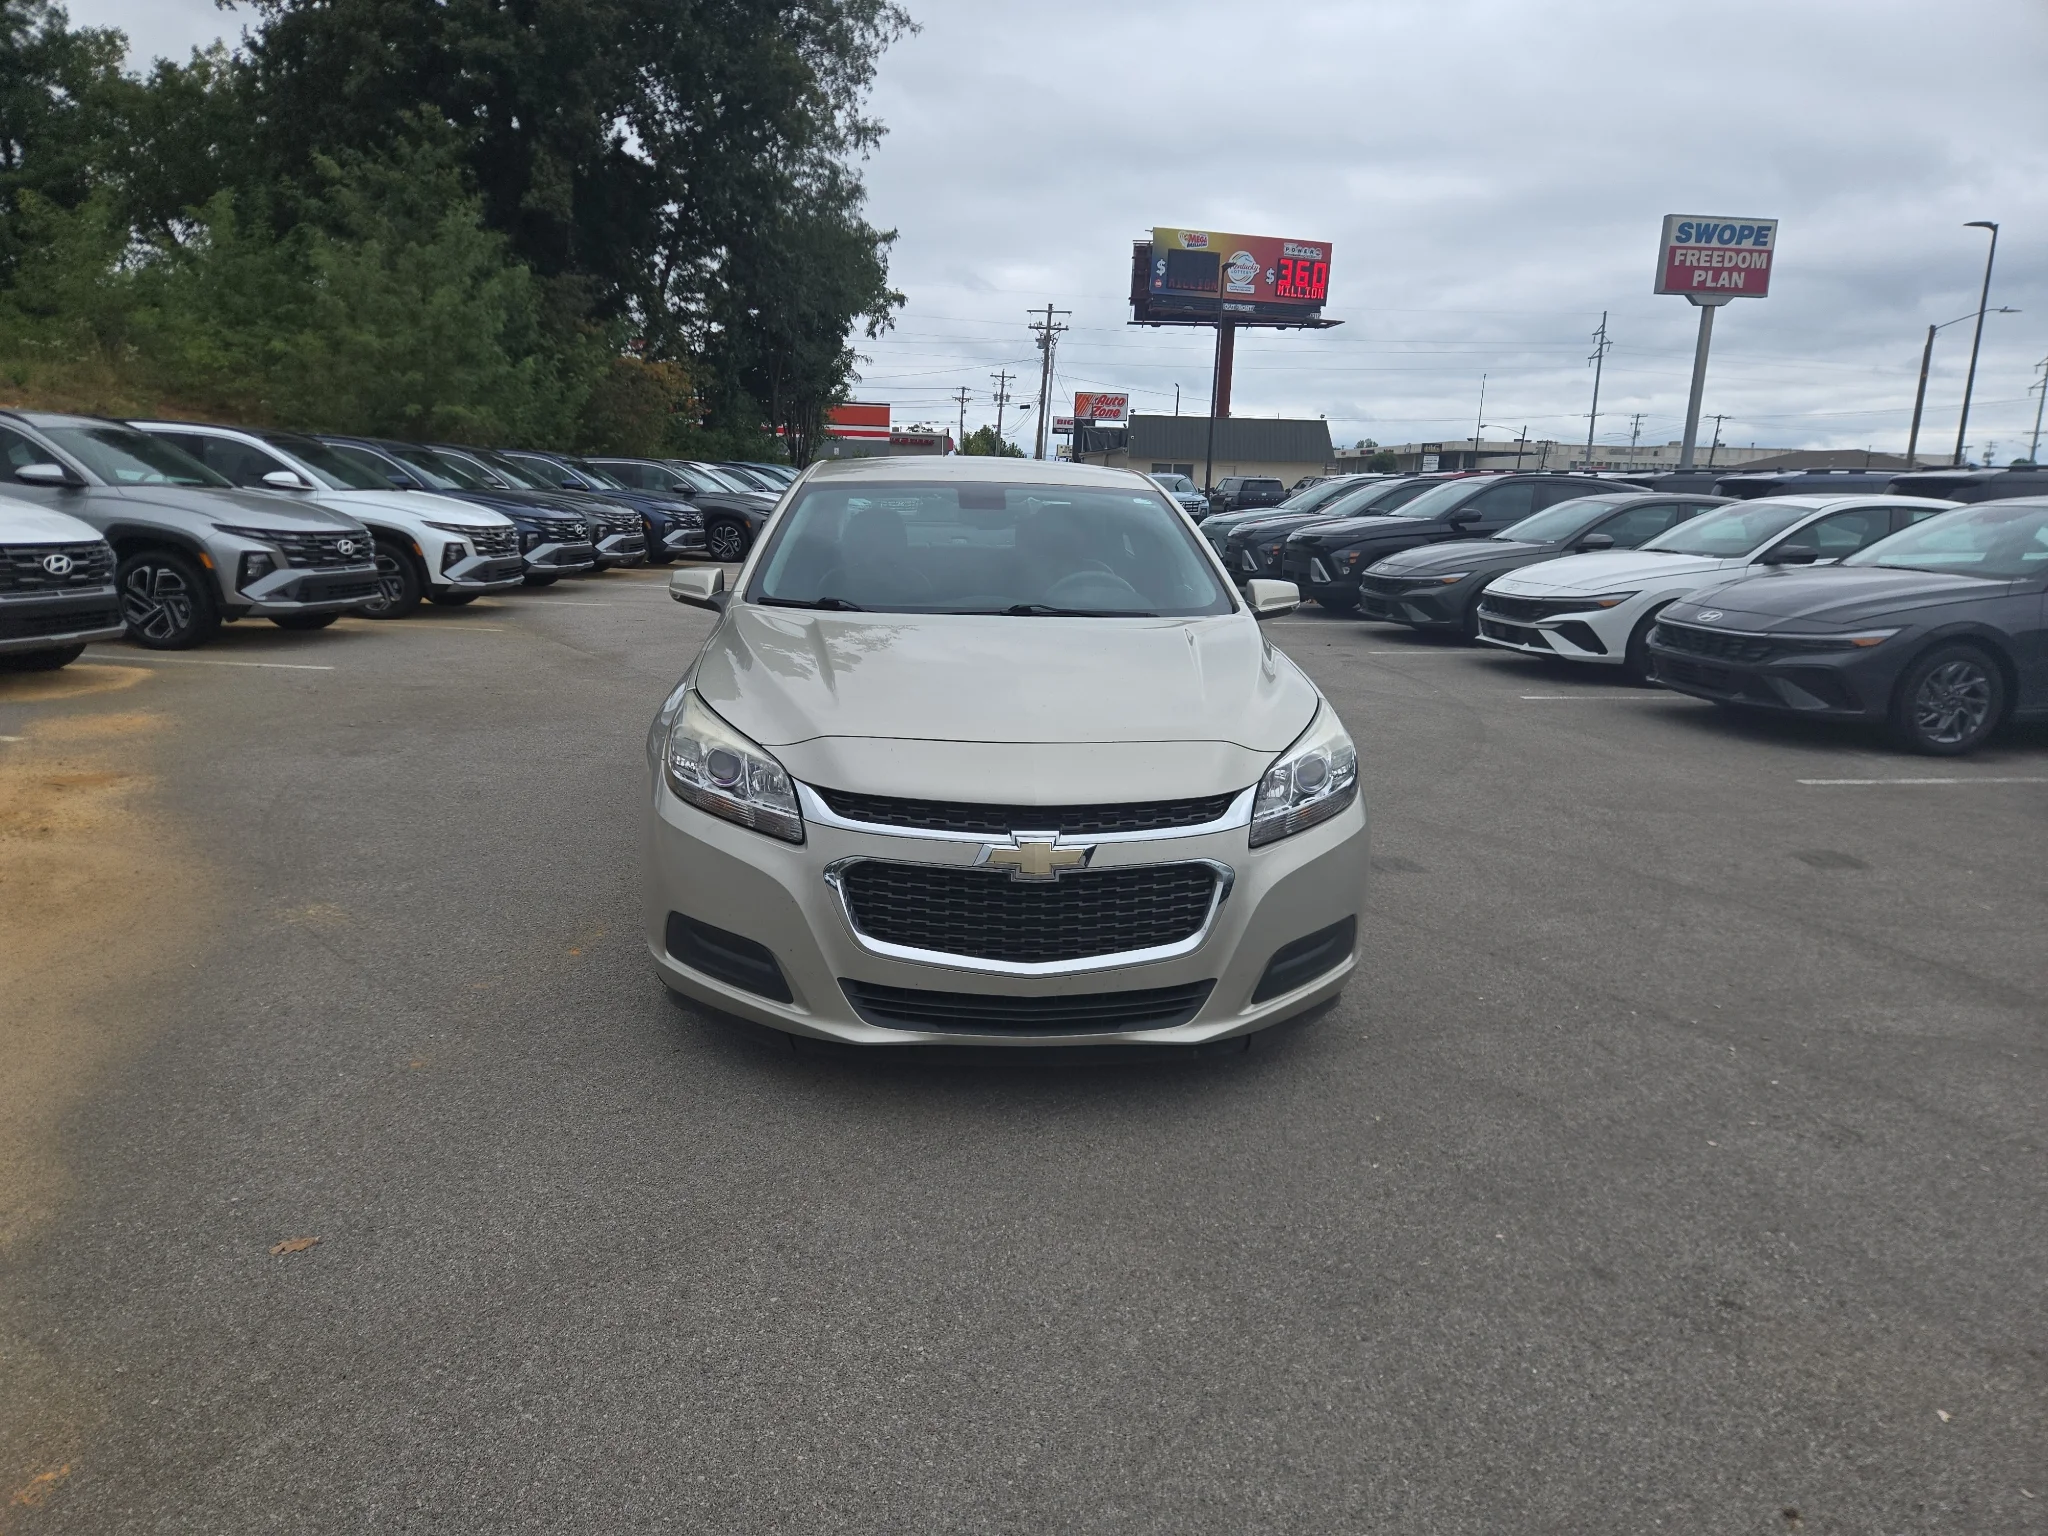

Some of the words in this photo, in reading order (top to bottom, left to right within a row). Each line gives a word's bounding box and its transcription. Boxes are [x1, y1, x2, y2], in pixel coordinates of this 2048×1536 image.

[1187, 233, 1208, 244] MEGA
[1676, 222, 1772, 246] SWOPE
[1285, 247, 1315, 255] POWER
[1674, 249, 1768, 269] FREEDOM
[1278, 259, 1327, 288] 360
[1692, 270, 1745, 288] PLAN
[1276, 284, 1325, 299] MILLION
[1097, 395, 1126, 407] Auto
[1092, 405, 1121, 419] Zone
